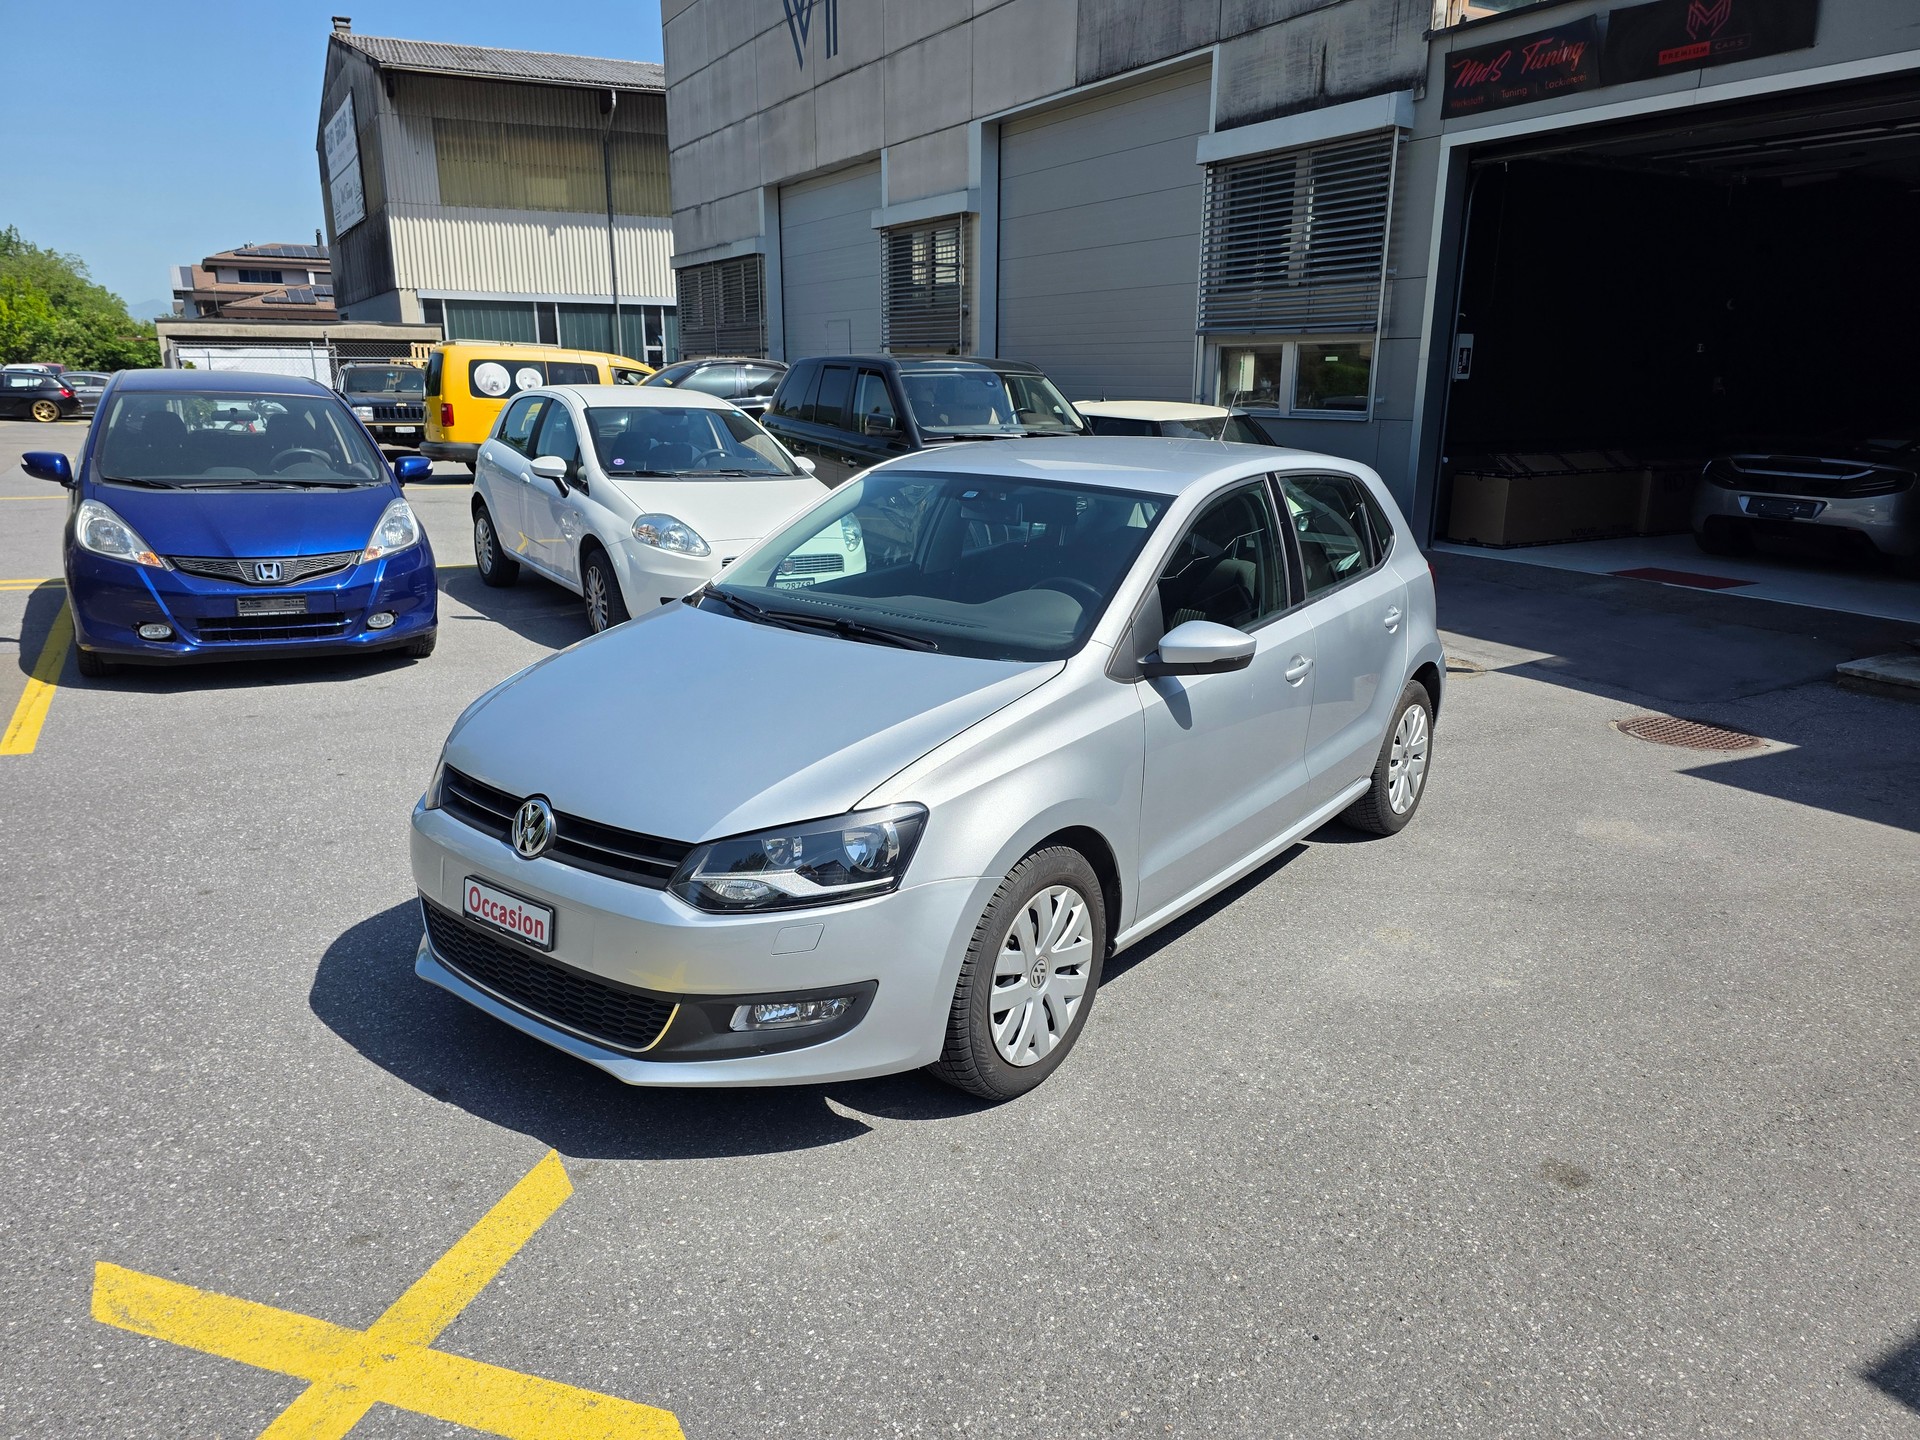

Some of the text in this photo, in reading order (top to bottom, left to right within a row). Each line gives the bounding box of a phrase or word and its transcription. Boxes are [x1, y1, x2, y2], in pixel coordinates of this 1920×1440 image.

[1521, 37, 1588, 74] Tuning
[1661, 38, 1745, 61] PREMIUM CARS
[1500, 87, 1528, 98] Tuning
[468, 886, 544, 941] Occasion
